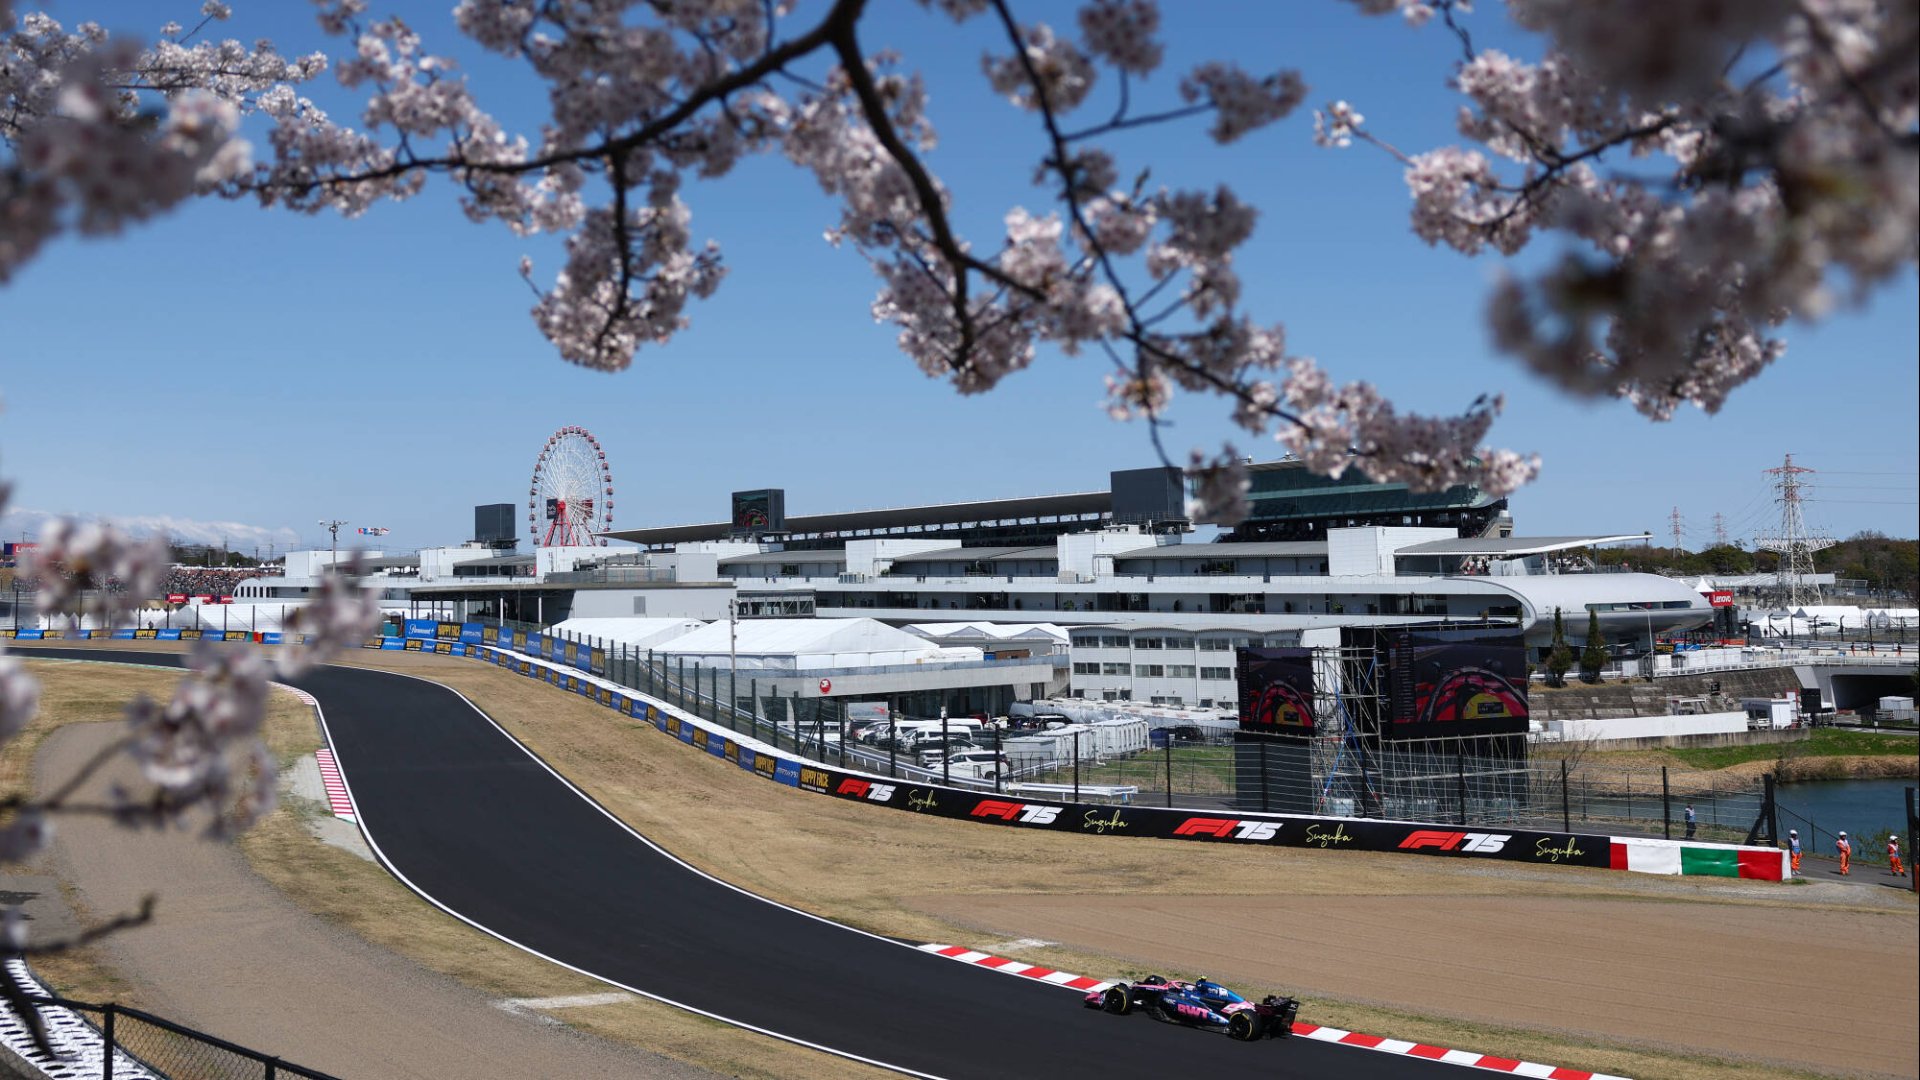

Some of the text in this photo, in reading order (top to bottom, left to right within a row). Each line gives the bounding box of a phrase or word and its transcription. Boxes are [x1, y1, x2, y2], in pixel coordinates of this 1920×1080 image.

[1712, 594, 1732, 603] Lenovo
[801, 768, 816, 785] HAPPY
[816, 771, 829, 788] FACE
[908, 789, 939, 811] Suzuka
[1083, 809, 1129, 833] Suzuka
[1305, 823, 1353, 848] Suzuka
[1535, 837, 1585, 862] Suzuka
[1178, 1003, 1208, 1019] BWT
